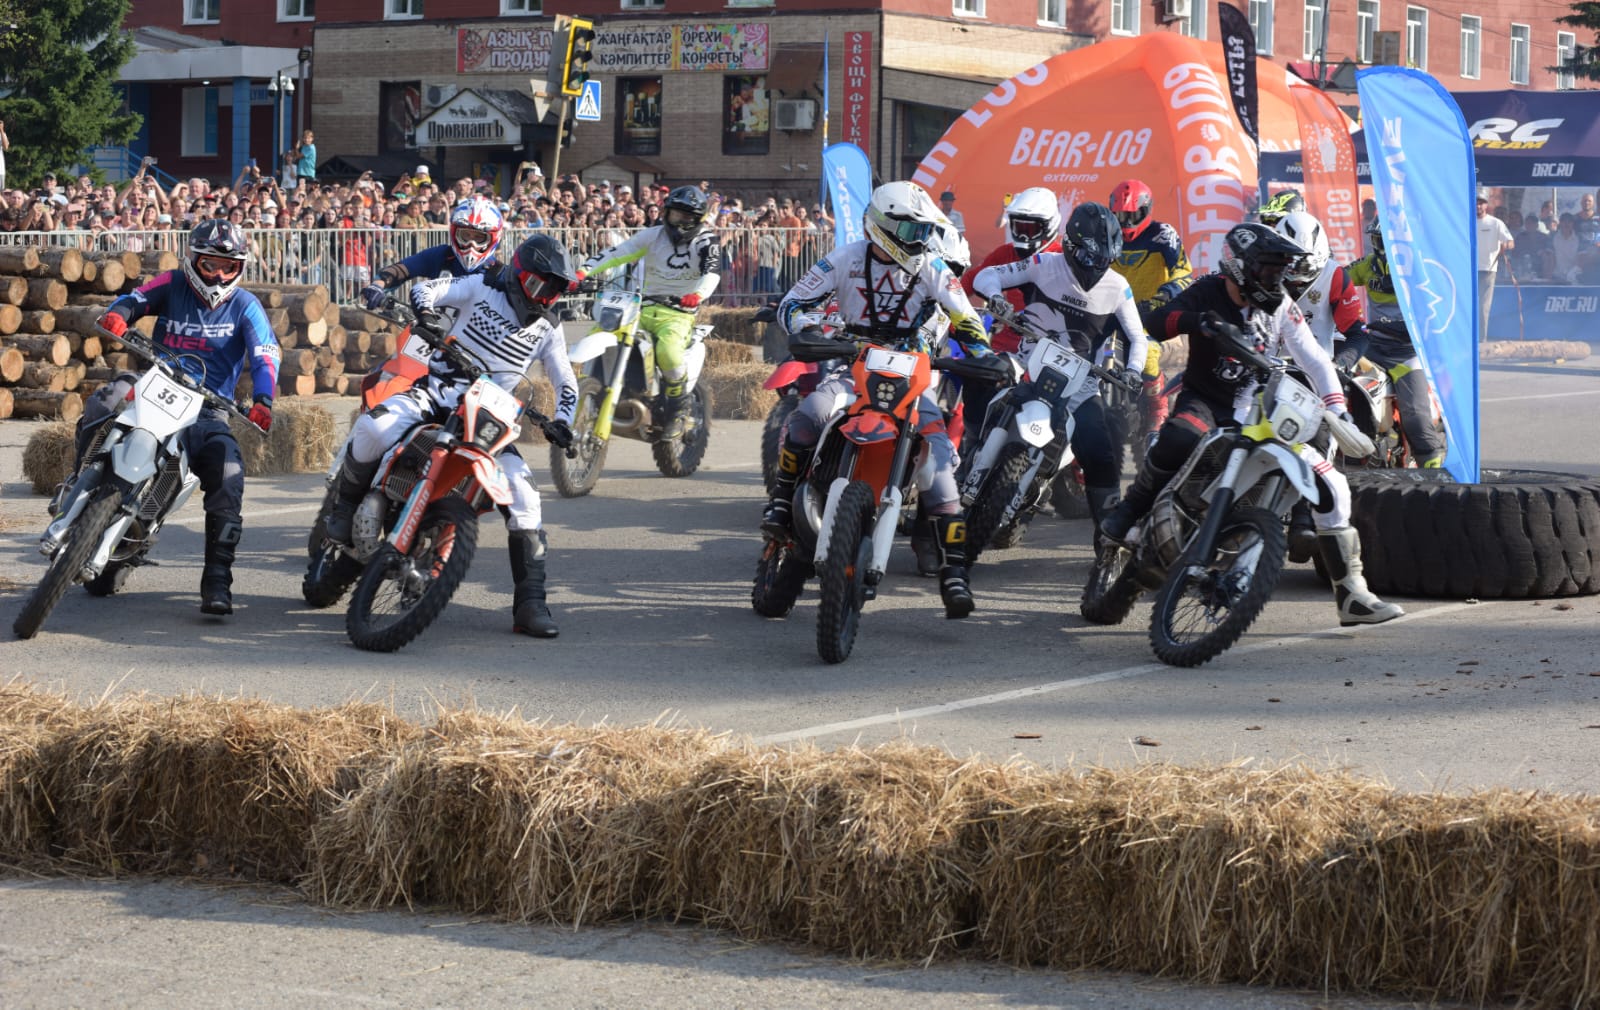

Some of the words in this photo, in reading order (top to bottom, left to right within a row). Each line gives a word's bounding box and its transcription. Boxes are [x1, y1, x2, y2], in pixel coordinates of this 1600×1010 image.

[682, 31, 722, 44] ОРЕХИ
[682, 51, 743, 64] КОНФЕТЫ
[1473, 138, 1547, 150] TEAM
[1042, 173, 1099, 183] extreme
[886, 355, 896, 366] 1
[1053, 354, 1071, 367] 27
[157, 388, 178, 406] 35
[401, 487, 430, 547] DUNLOP
